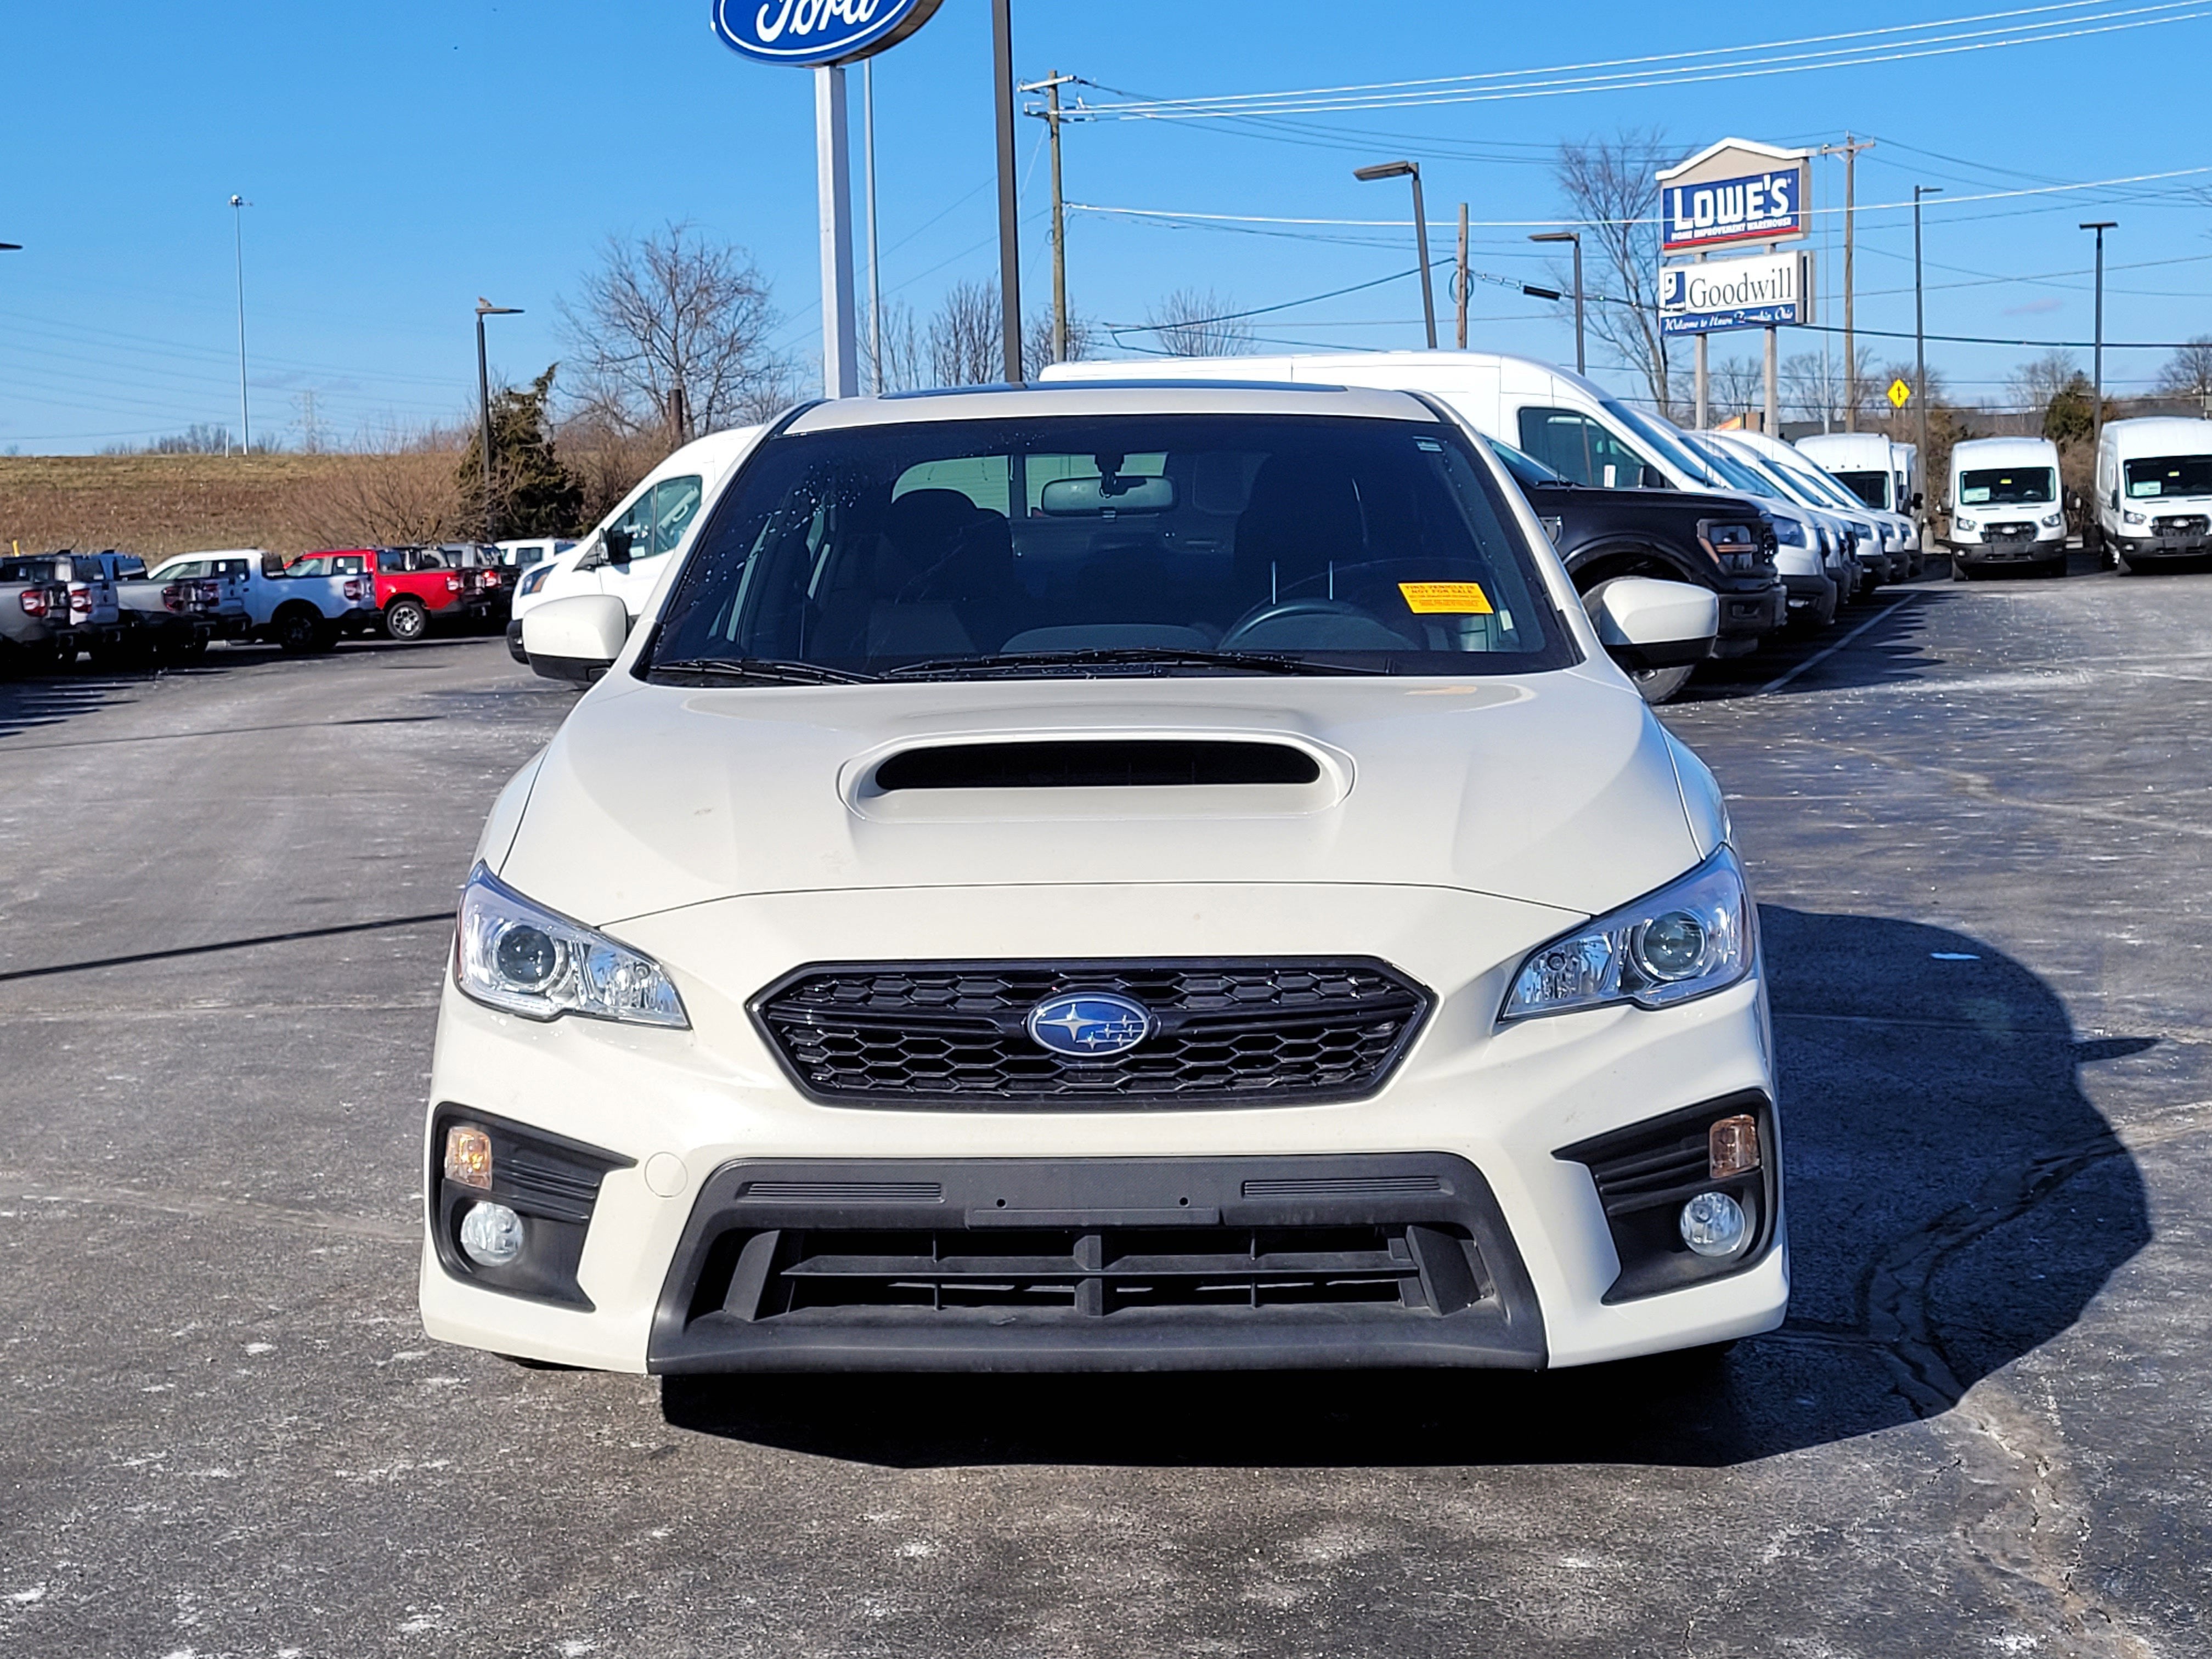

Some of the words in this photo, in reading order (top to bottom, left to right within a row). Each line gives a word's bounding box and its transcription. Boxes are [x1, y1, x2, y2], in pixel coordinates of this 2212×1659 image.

[1673, 174, 1790, 231] LOWE'S
[1694, 222, 1746, 238] IMPROVEMENT
[1747, 217, 1792, 231] WAREHOUSE
[1689, 266, 1792, 308] Goodwill
